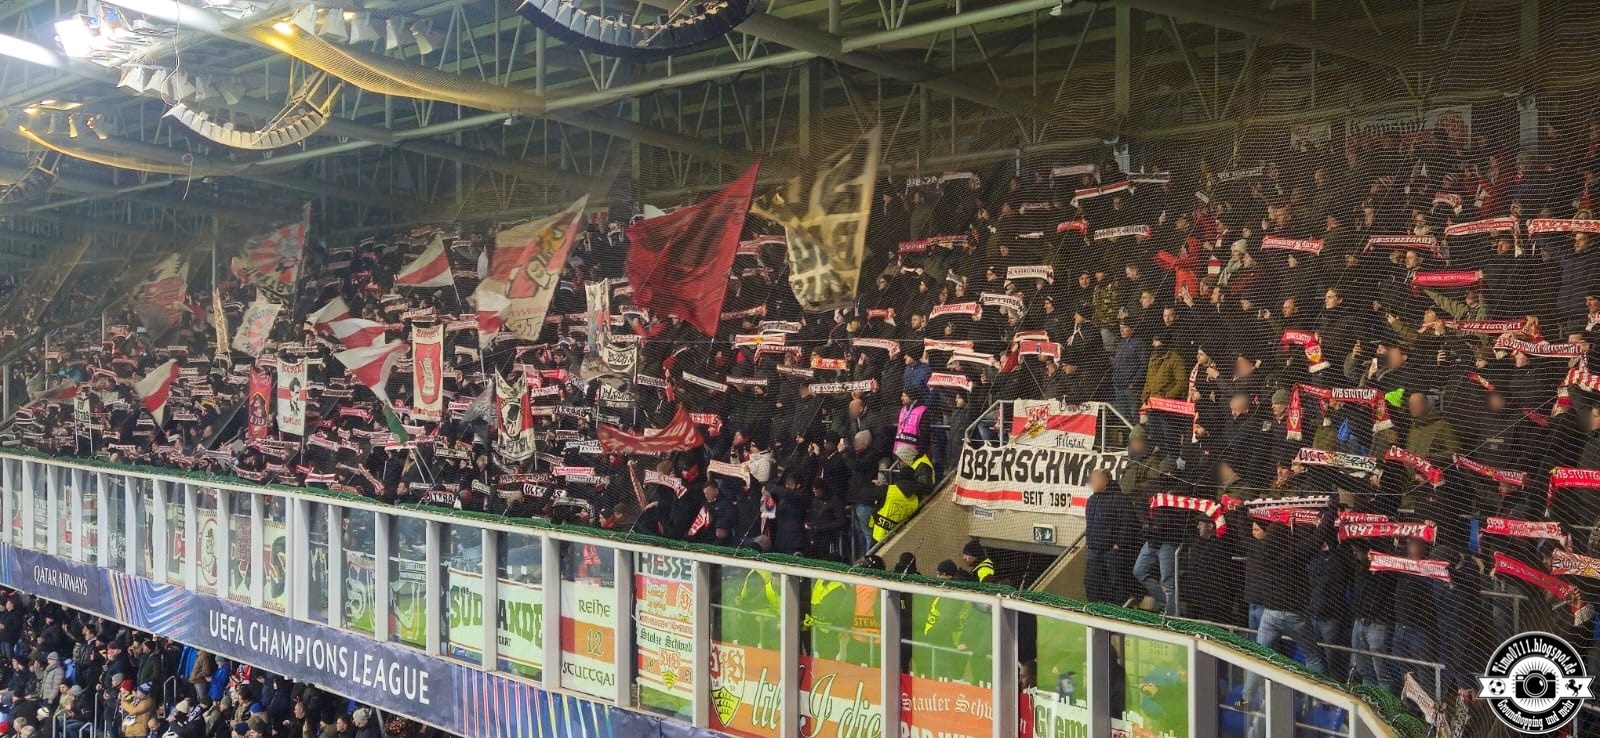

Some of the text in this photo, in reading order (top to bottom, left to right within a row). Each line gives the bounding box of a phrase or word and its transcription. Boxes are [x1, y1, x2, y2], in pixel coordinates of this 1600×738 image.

[1023, 491, 1072, 509] SEIT 1997
[34, 565, 88, 596] QATAR AIRWAYS
[587, 630, 603, 656] 12
[209, 609, 430, 705] UEFA CHAMPIONS LEAGUE
[901, 692, 950, 714] Staufer
